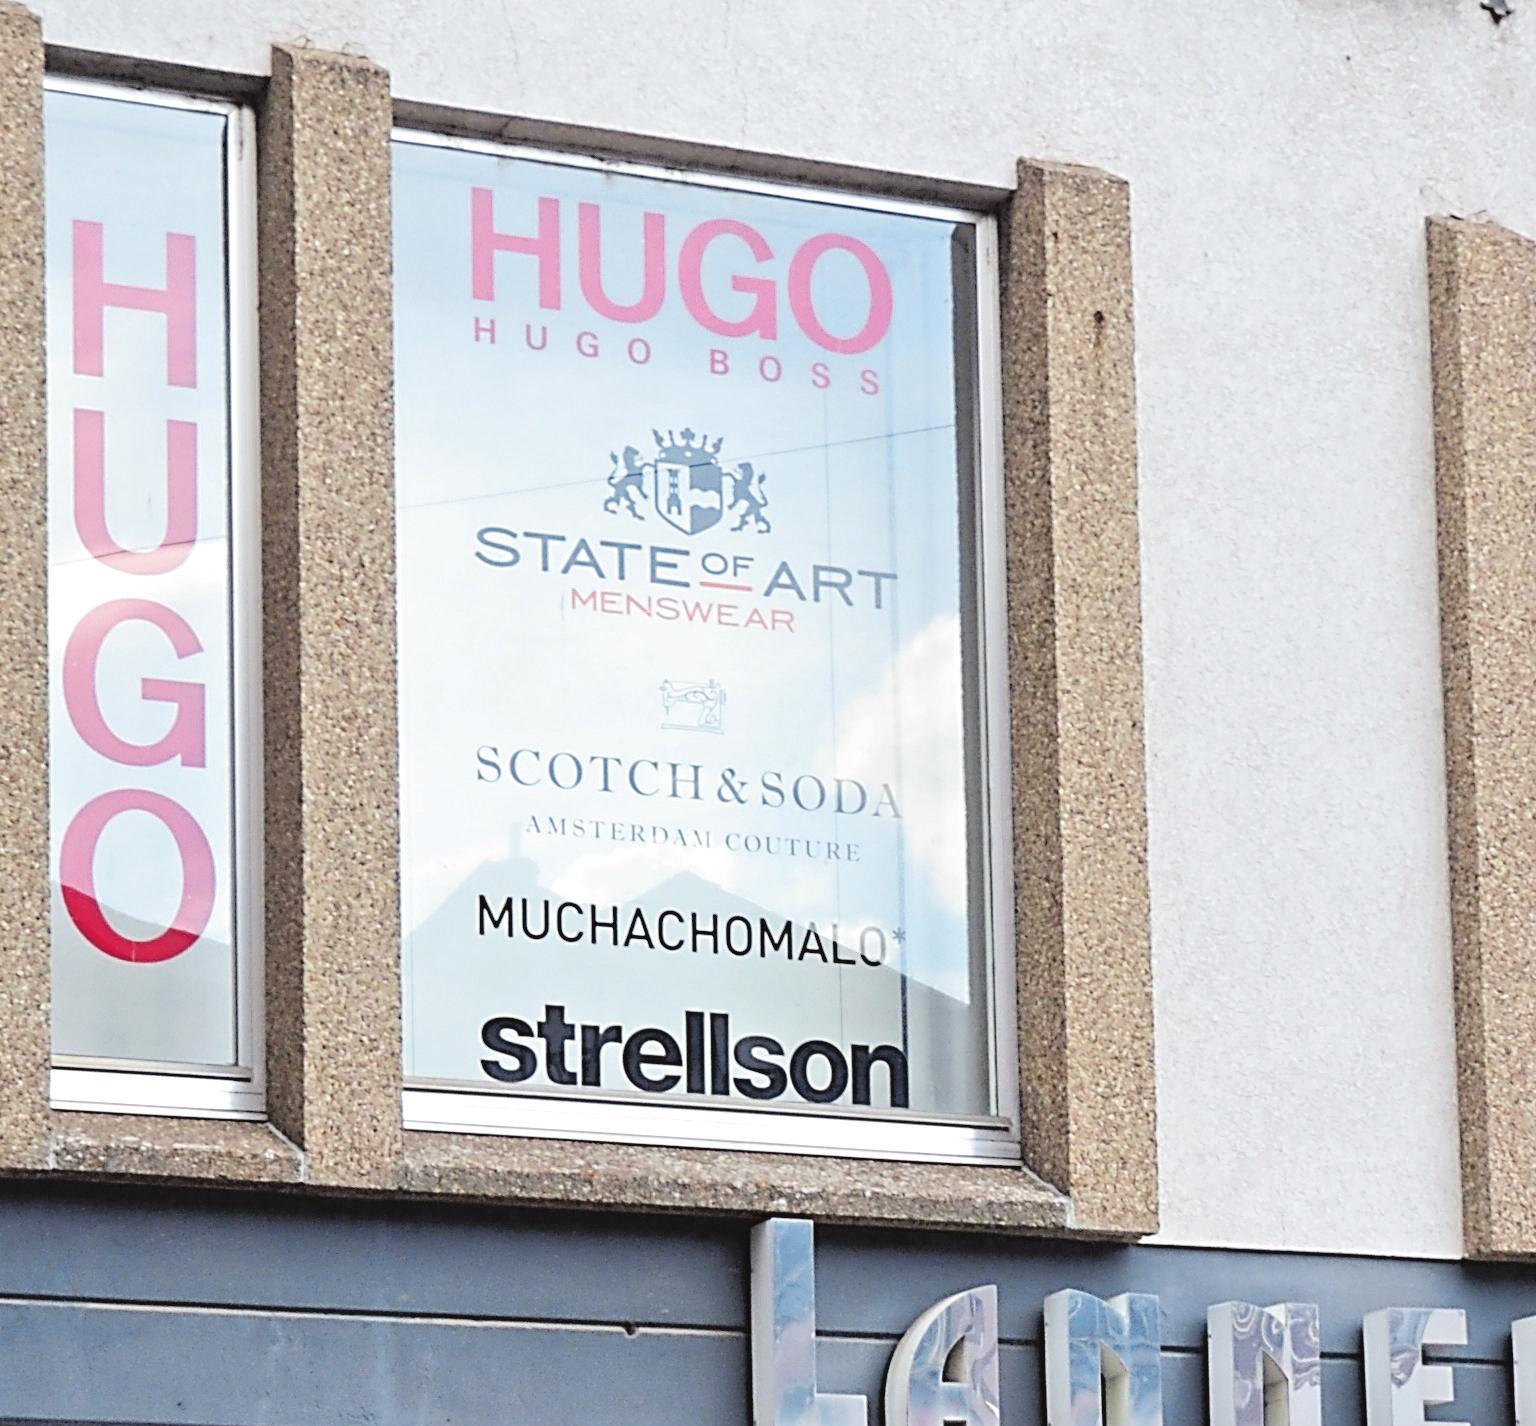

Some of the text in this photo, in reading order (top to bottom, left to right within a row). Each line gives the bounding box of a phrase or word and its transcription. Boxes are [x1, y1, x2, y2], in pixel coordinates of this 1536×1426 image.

[470, 187, 895, 356] HUGO
[474, 317, 880, 396] HUGO BOSS
[59, 219, 216, 964] HUGO
[475, 526, 898, 610] STATE OF ART
[570, 587, 796, 634] MENSWEAR
[476, 746, 702, 800] SCOTCH
[761, 772, 903, 820] SODA
[526, 815, 861, 864] AMSTERDAM COUTURE
[480, 1004, 910, 1109] strellson
